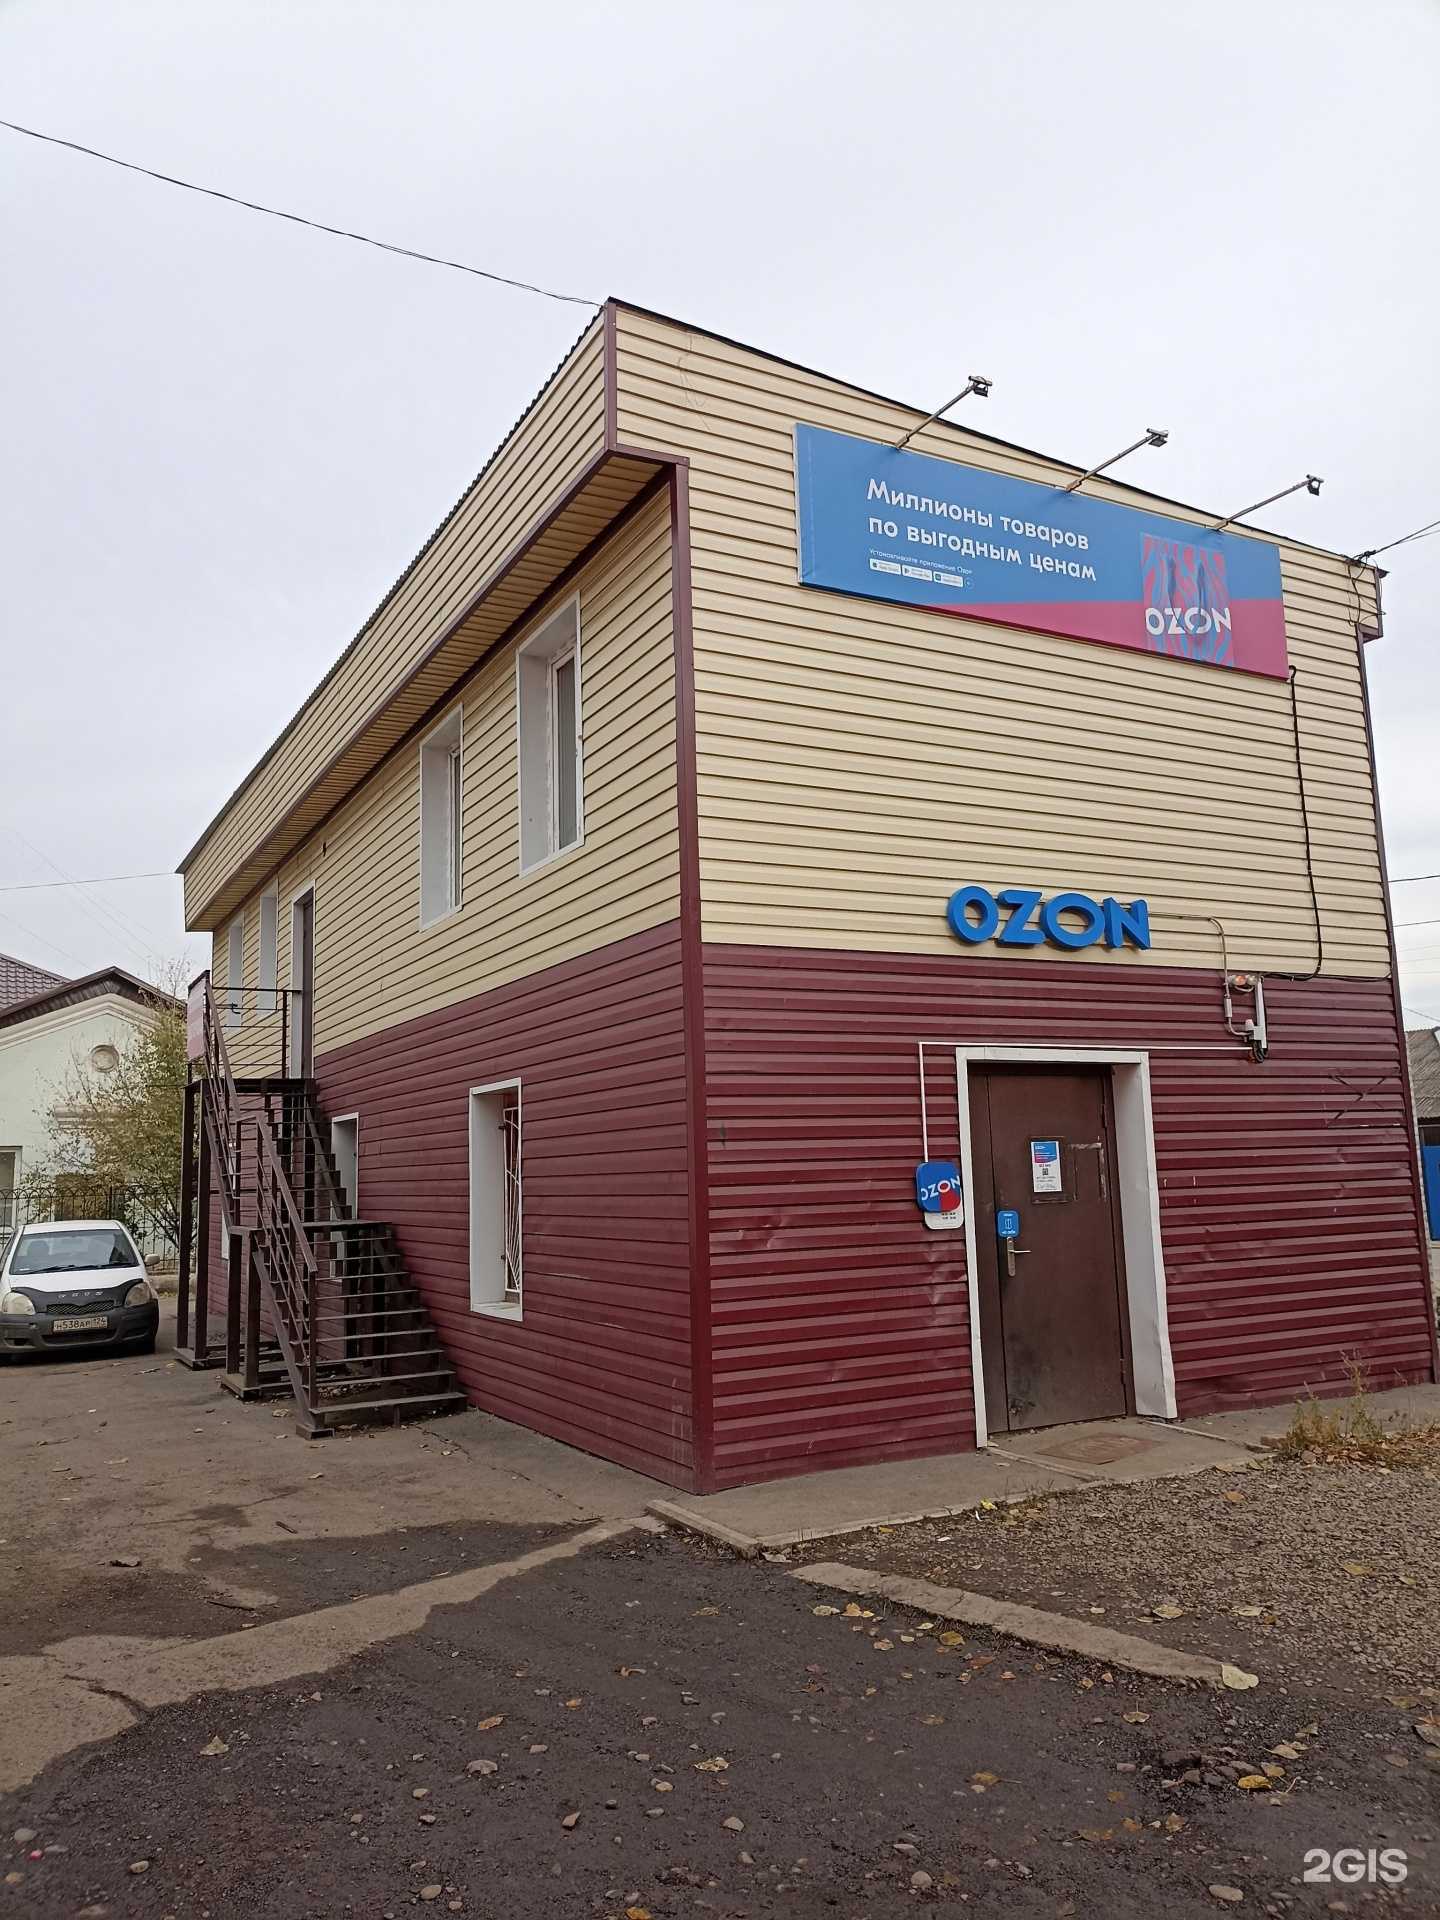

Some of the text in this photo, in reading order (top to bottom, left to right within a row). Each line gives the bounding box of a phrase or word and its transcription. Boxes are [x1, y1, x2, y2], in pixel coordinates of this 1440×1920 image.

[867, 478, 1089, 550] Миллионы товаров
[869, 517, 1097, 582] по выгодным ценам
[1145, 607, 1232, 635] OZON
[948, 885, 1151, 951] OZON
